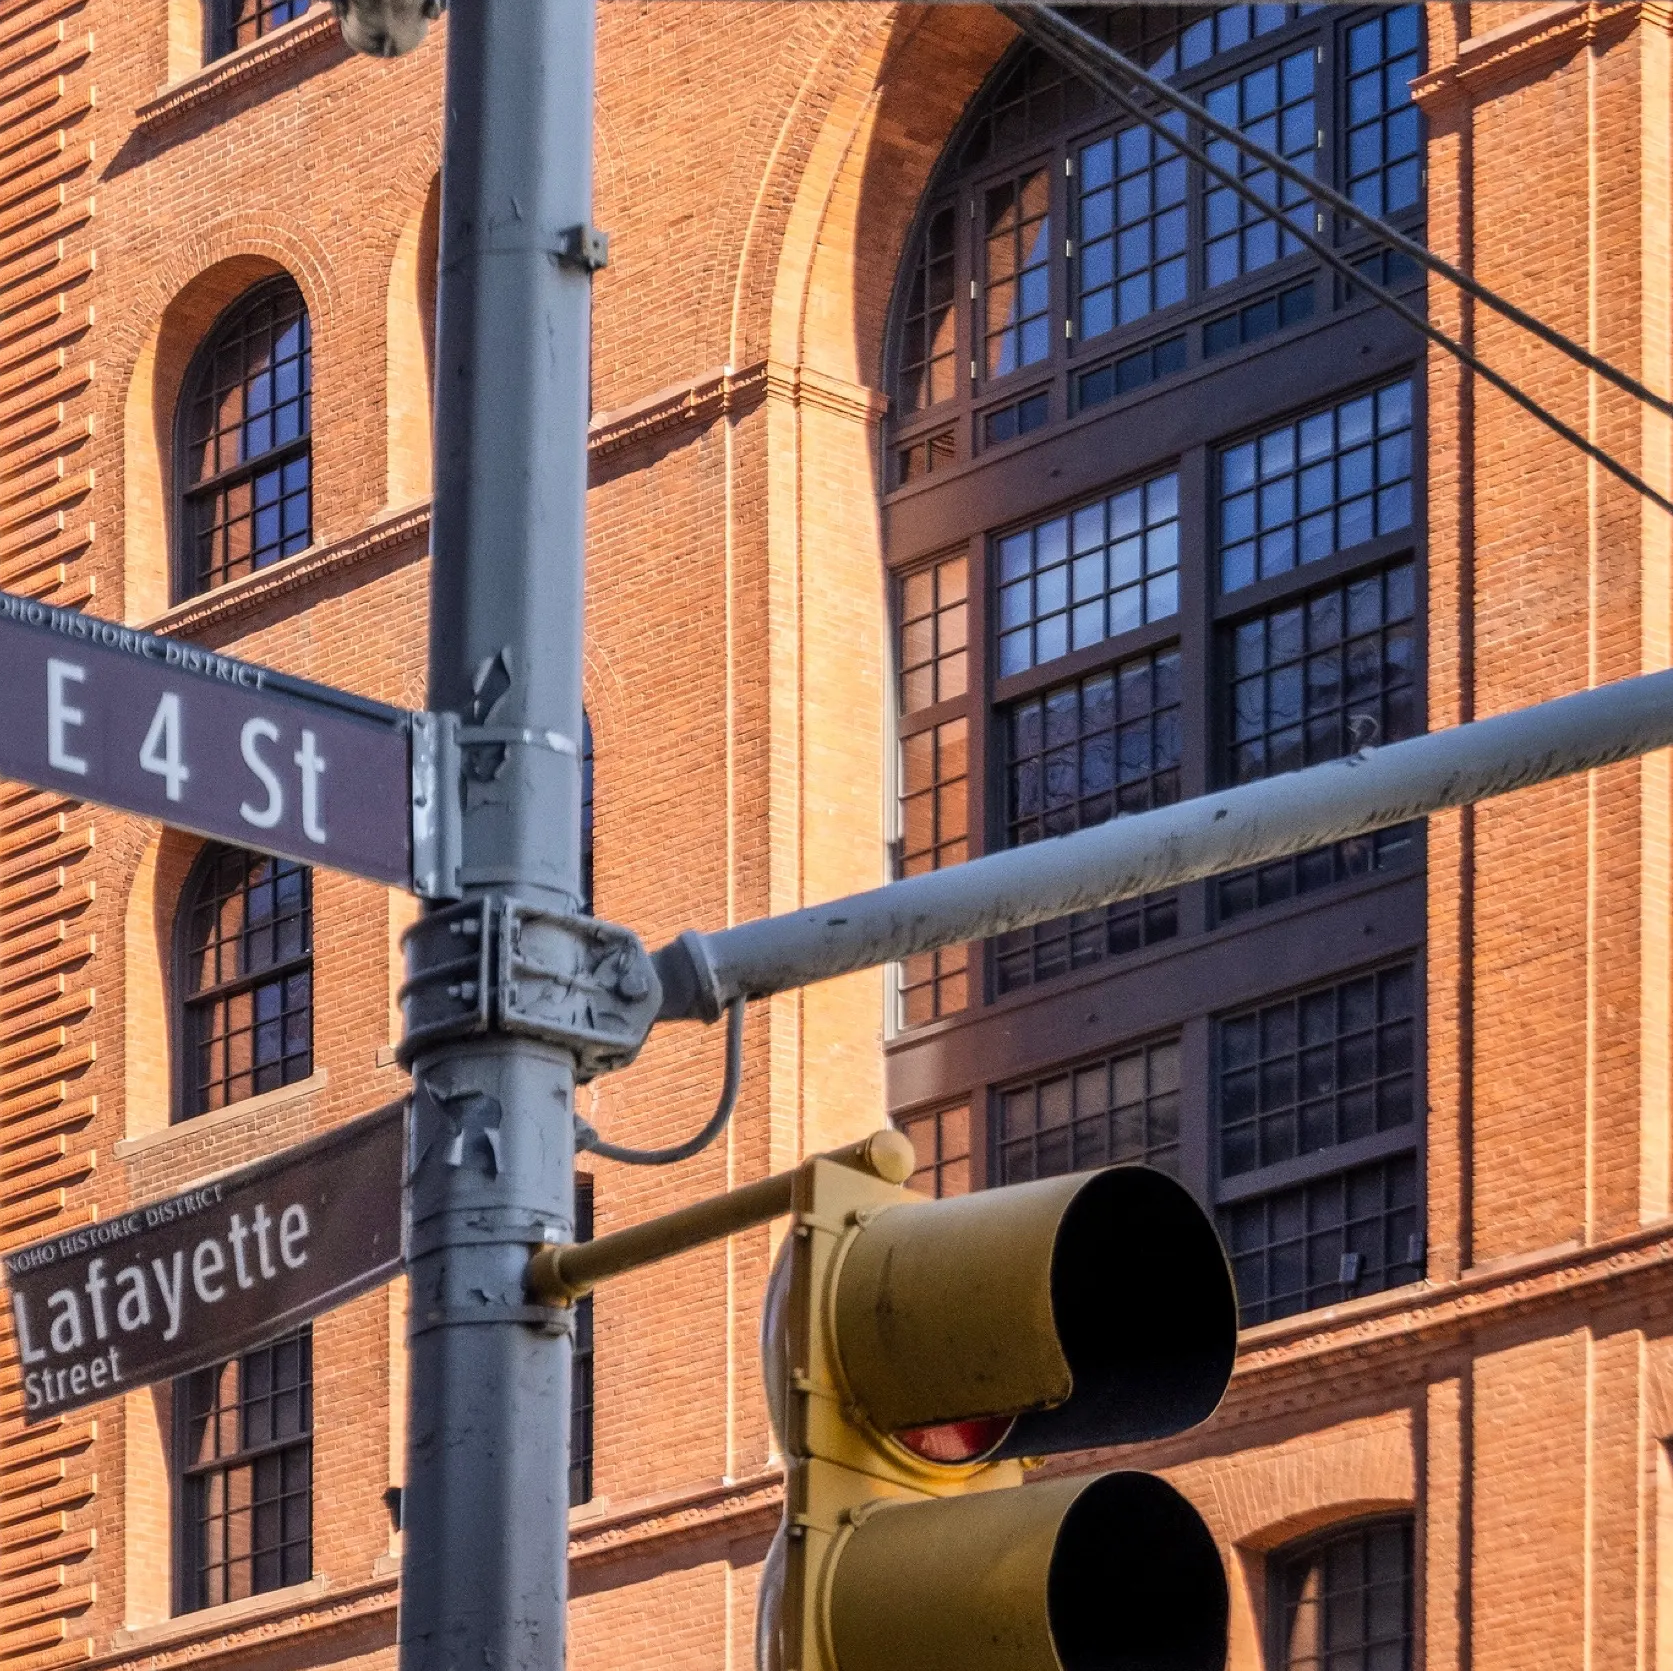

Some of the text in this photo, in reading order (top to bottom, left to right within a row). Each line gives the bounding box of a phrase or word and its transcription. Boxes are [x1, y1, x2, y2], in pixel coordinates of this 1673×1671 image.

[50, 610, 158, 659] HISTORIC
[165, 639, 268, 691] DISTRICT
[45, 657, 328, 845] E 4 St
[7, 1183, 224, 1273] NOHO HISTORIC DISTRICT
[11, 1201, 310, 1365] Lafayette
[25, 1344, 125, 1411] Street
